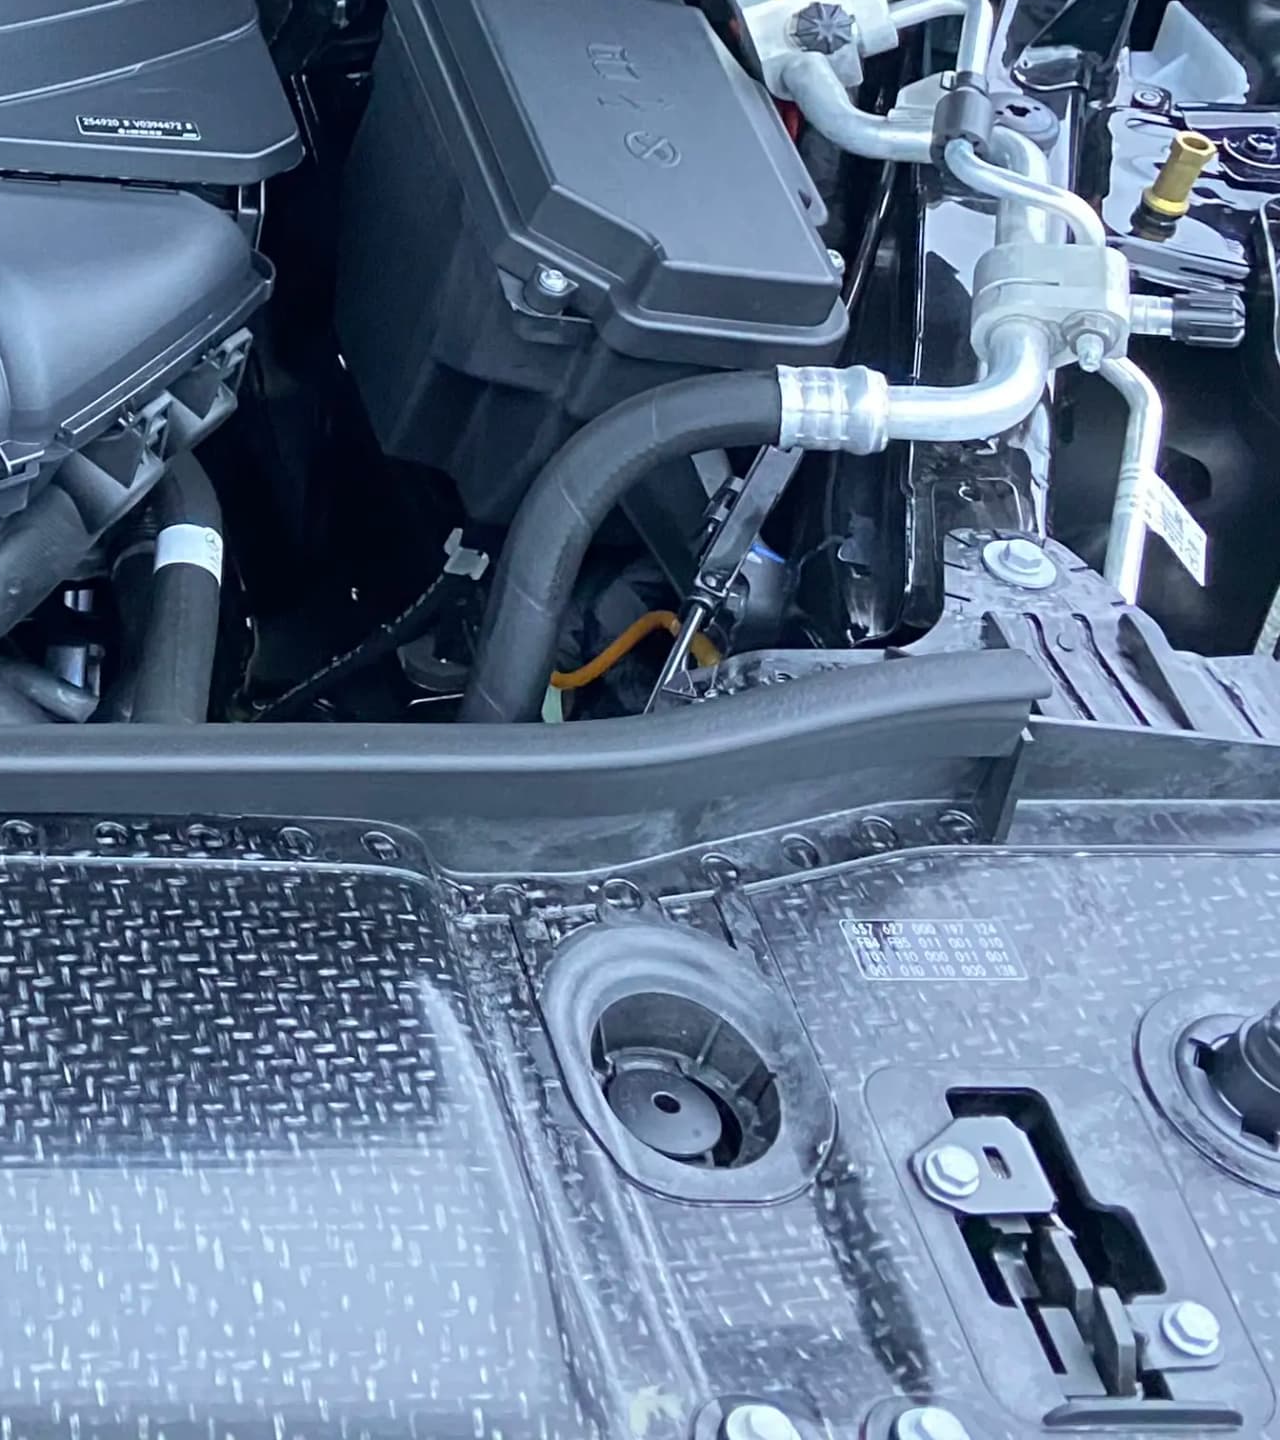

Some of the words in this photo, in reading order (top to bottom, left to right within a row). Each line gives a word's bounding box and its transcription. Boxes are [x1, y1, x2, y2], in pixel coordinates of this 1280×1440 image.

[856, 937, 880, 949] FB4
[887, 937, 911, 949] FB5
[918, 937, 942, 949] 011
[948, 937, 973, 949] 001
[978, 937, 1004, 949] 010
[895, 951, 919, 963] 110
[954, 951, 979, 963] 011
[985, 951, 1009, 963] 001
[900, 964, 926, 977] 010
[932, 964, 956, 977] 110
